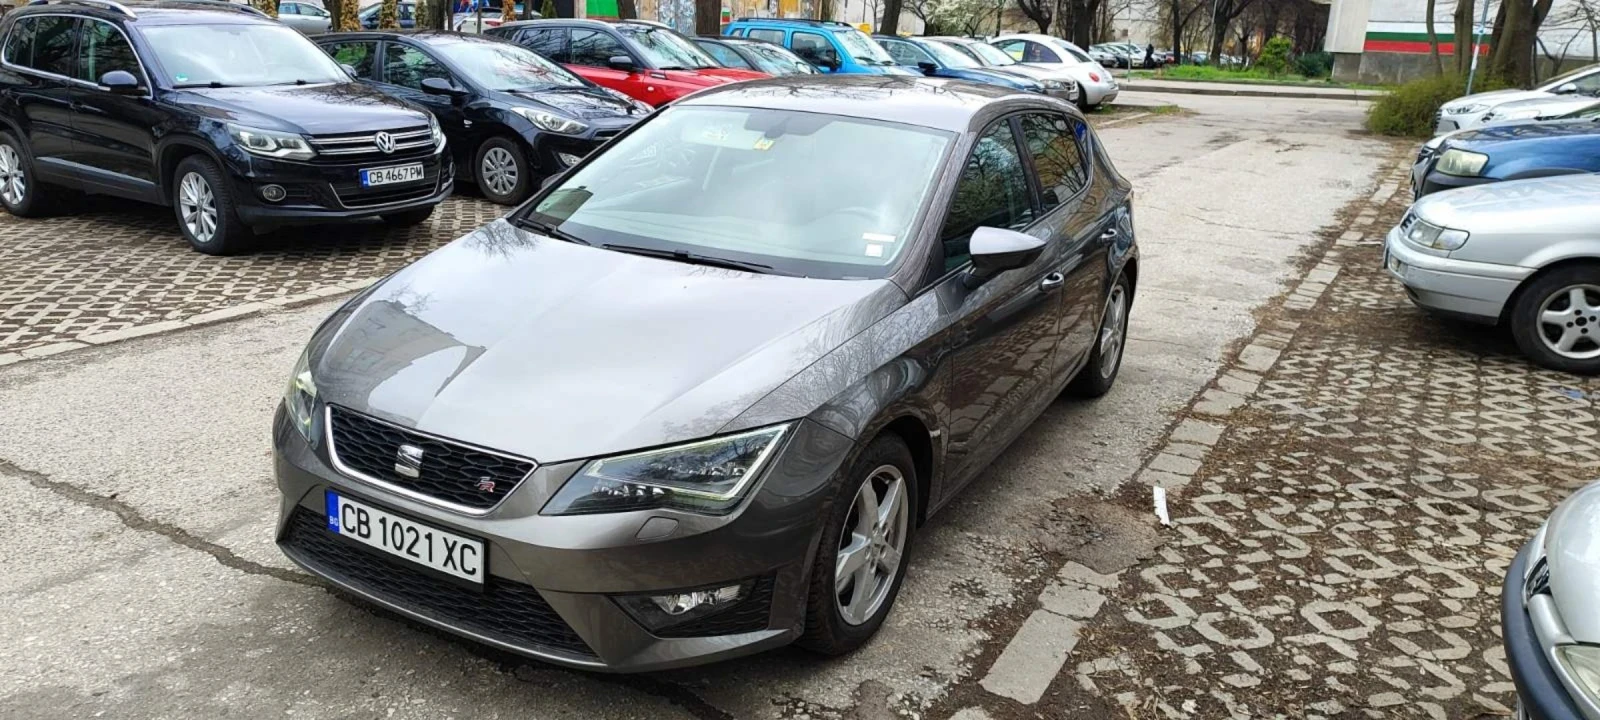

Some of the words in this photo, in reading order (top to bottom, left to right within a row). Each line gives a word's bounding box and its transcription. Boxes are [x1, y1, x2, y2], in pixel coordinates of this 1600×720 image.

[369, 172, 383, 183] CB
[386, 167, 408, 182] 4667
[410, 166, 422, 179] PM
[342, 503, 371, 539] CB
[379, 516, 433, 562] 1021
[442, 536, 477, 575] XC
